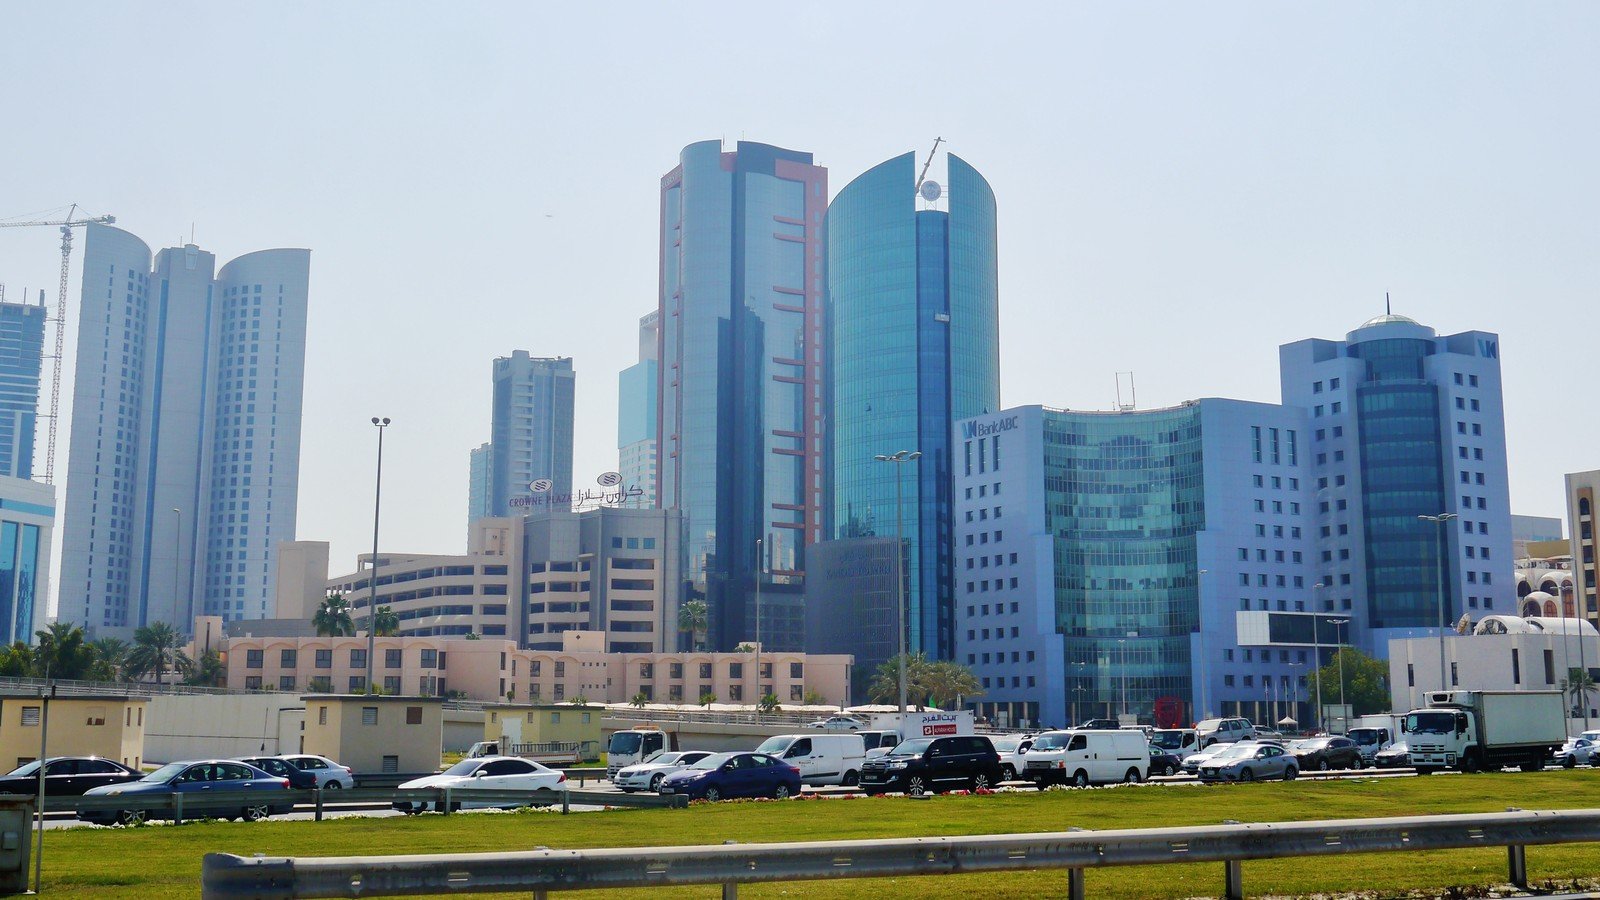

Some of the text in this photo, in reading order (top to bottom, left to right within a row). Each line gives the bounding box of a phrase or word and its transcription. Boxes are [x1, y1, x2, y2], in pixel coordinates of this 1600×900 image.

[509, 494, 573, 508] CROWNE PLAZA
[577, 485, 644, 507] كراون بلازا
